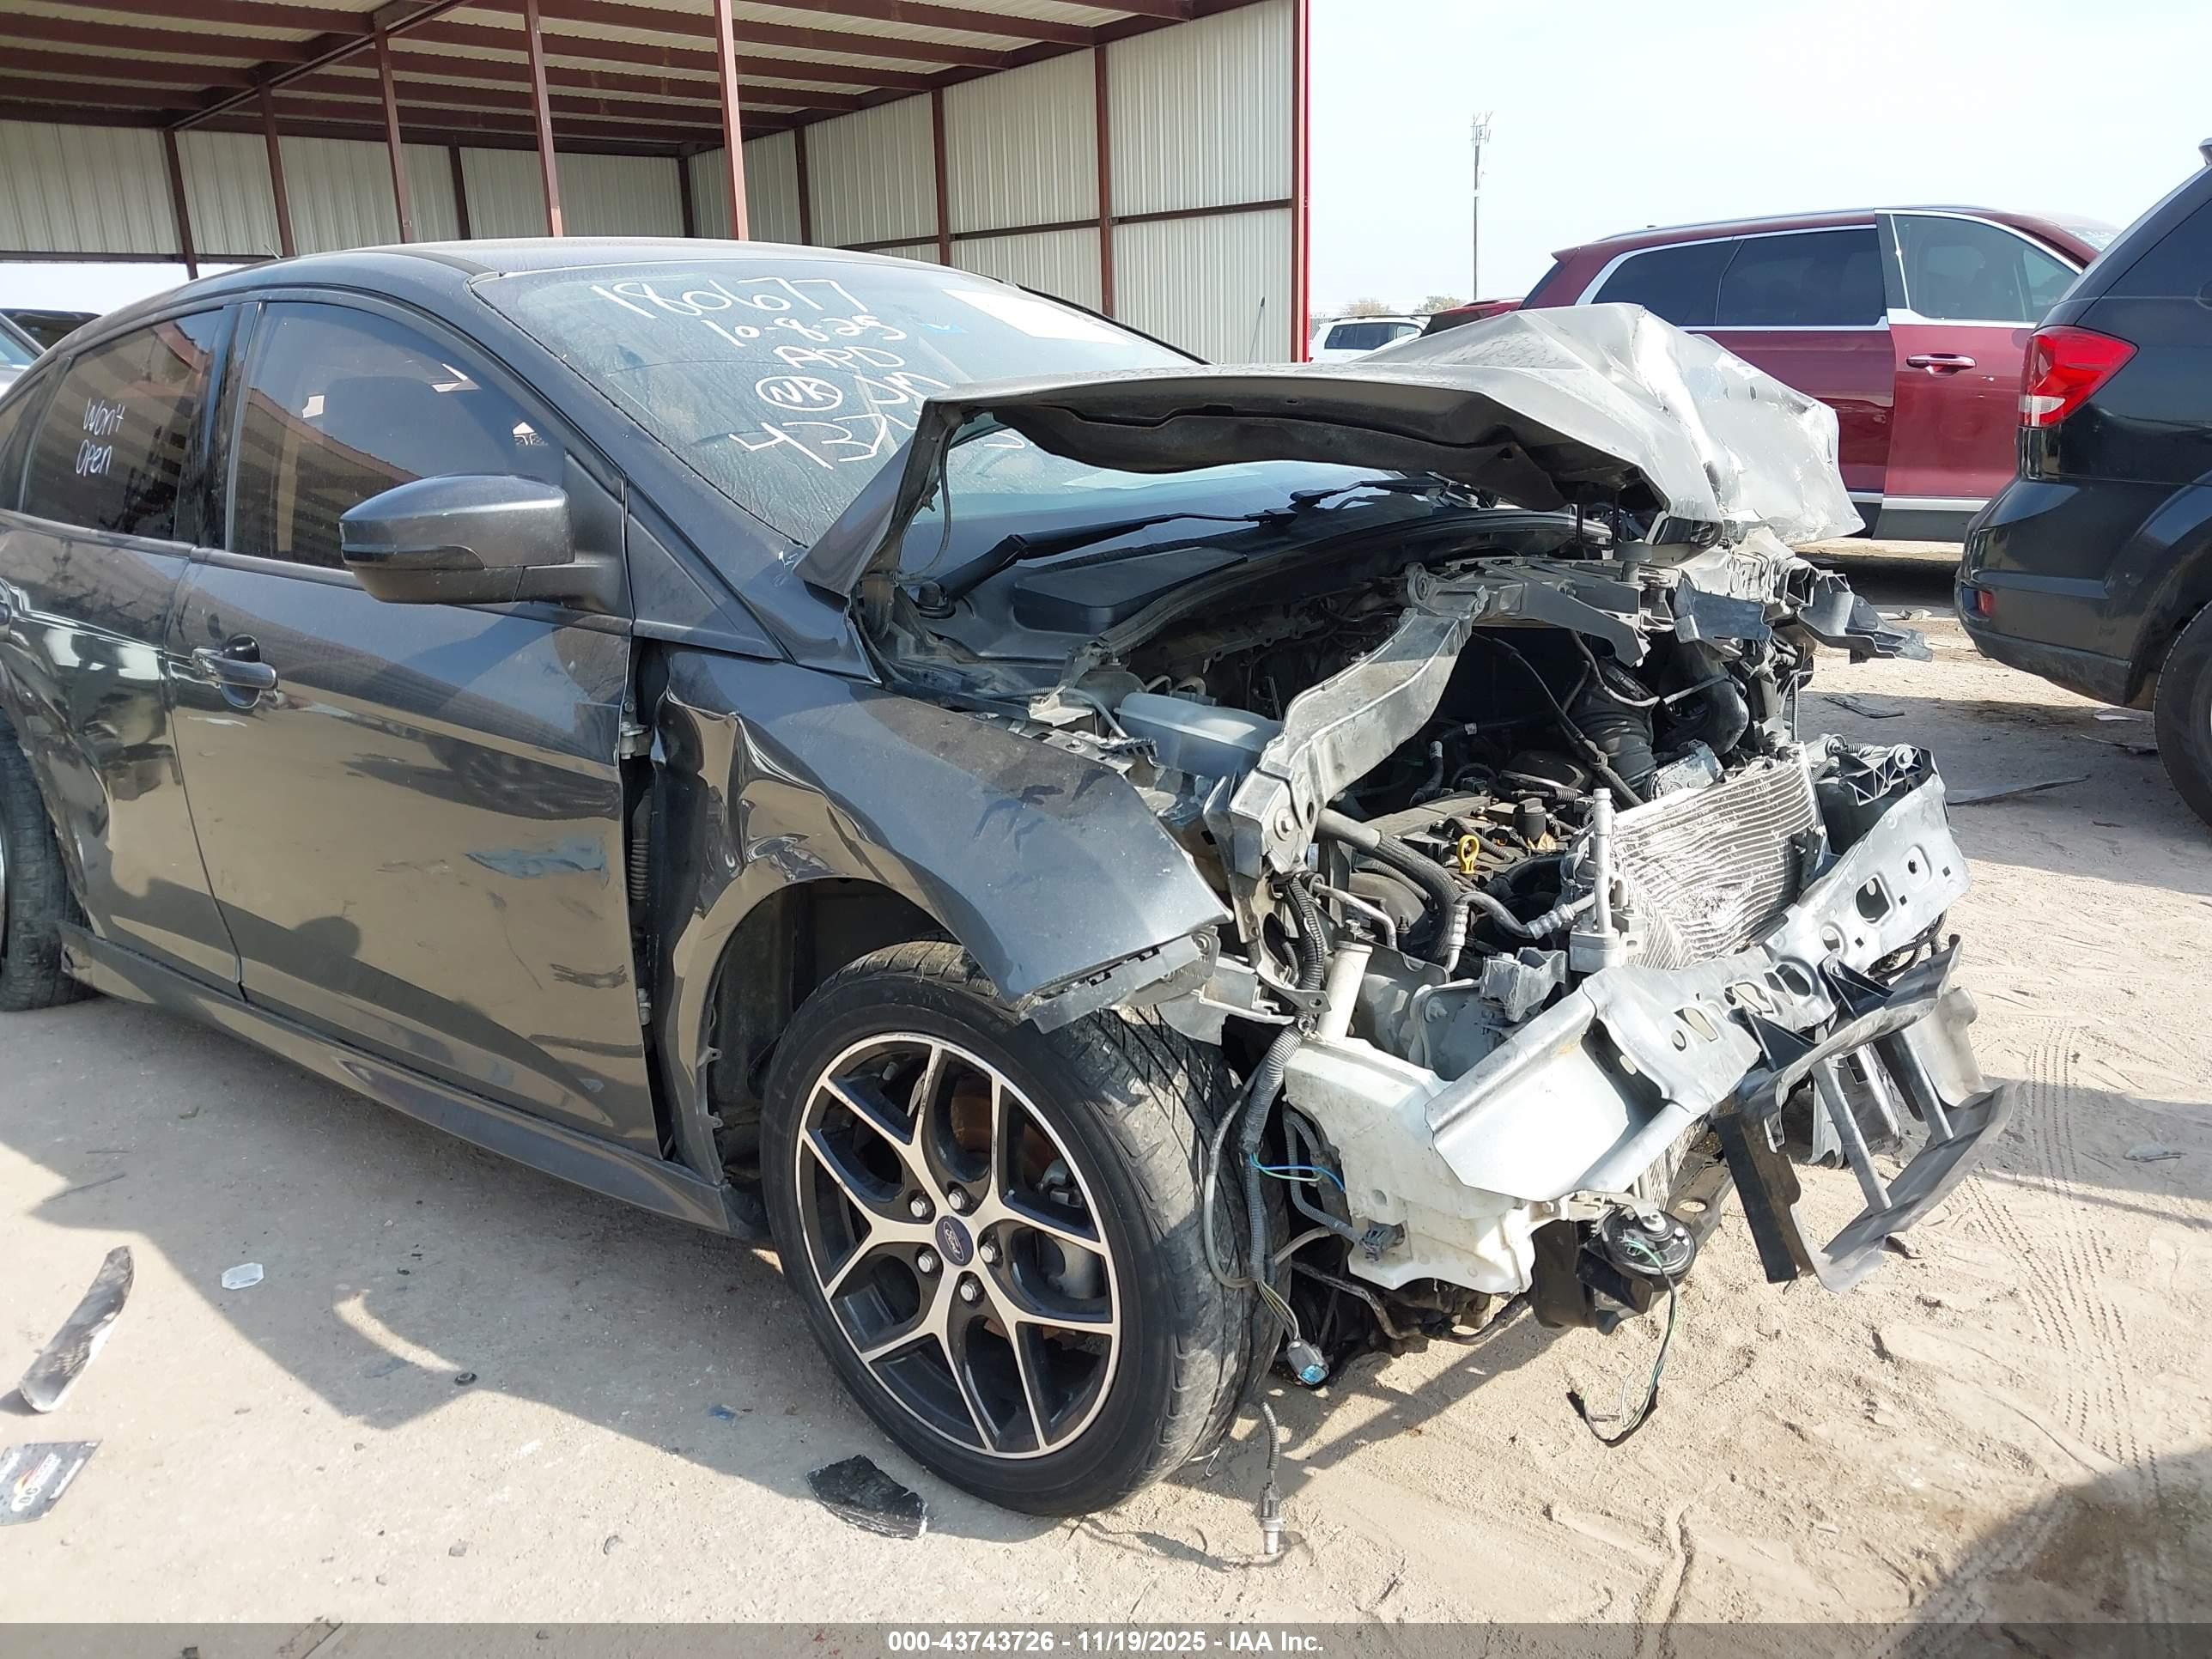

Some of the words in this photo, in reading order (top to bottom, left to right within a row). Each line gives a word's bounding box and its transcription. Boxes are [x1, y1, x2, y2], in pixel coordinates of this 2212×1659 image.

[589, 276, 869, 319] 180677
[773, 345, 906, 369] APD
[945, 1228, 961, 1255] Ford
